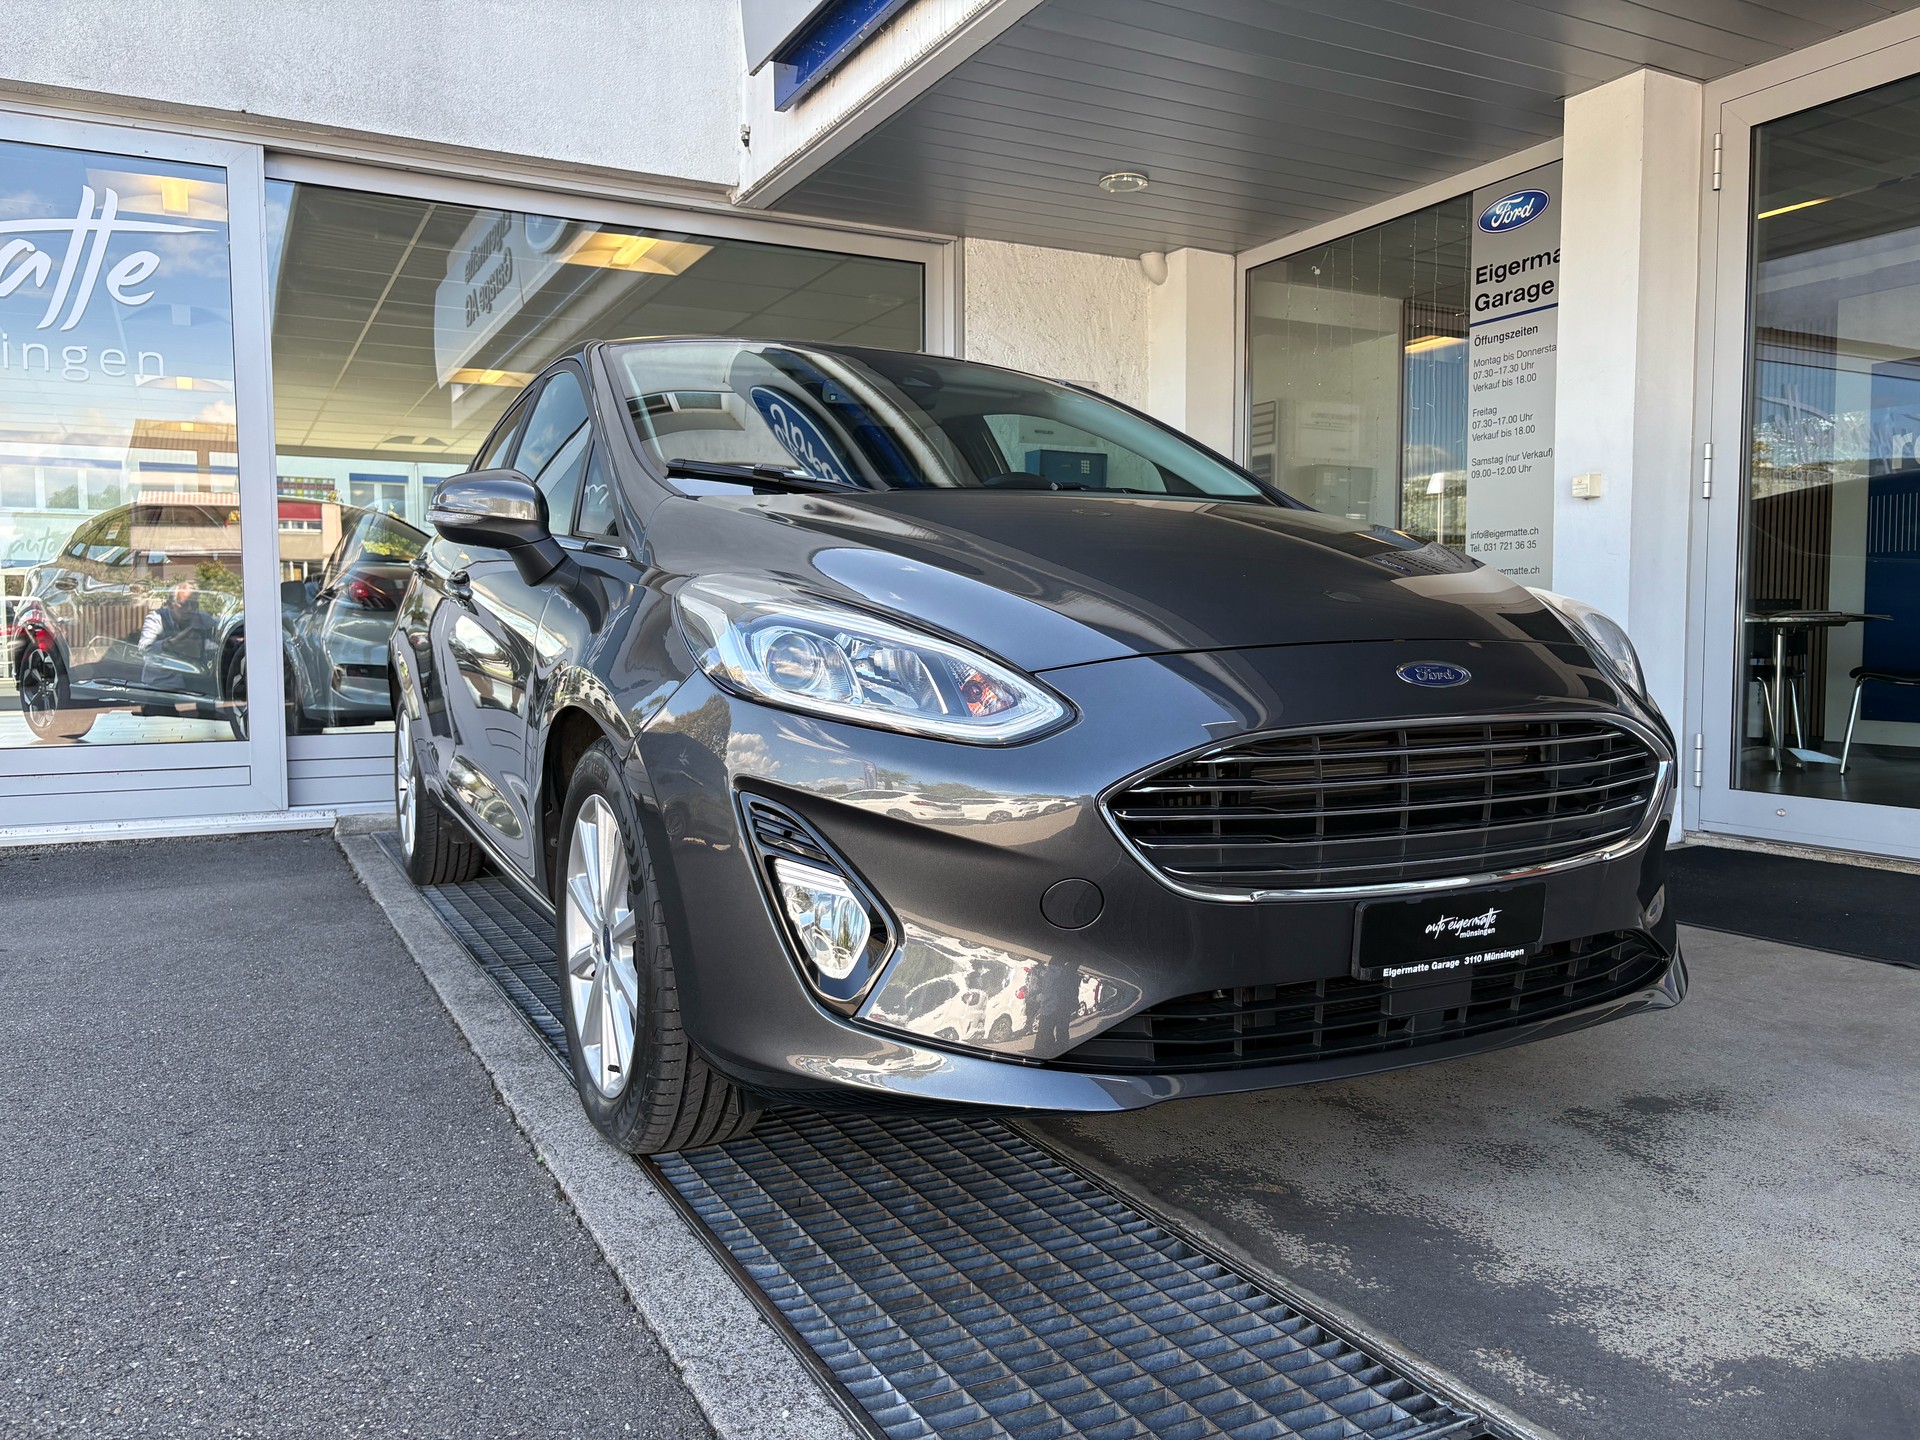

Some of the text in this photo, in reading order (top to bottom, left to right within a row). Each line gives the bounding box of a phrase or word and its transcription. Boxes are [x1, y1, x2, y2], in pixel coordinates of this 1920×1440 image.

[1474, 280, 1555, 312] Garage
[1473, 354, 1501, 368] Montag
[1503, 351, 1514, 362] bis
[1520, 361, 1535, 372] Uhr
[1473, 373, 1537, 393] Verkauf bis 18.00
[1472, 406, 1498, 418] Freitag
[1520, 412, 1534, 423] Uhr
[1472, 425, 1536, 442] Verkauf bis 18.00
[1471, 447, 1554, 468] Samstag (nur Verkauf)
[1518, 463, 1533, 474] Uhr
[1470, 526, 1539, 540] info@eigermatte.ch
[1470, 540, 1537, 553] Tel. 031 721 36 35
[1415, 666, 1455, 681] Ford
[1425, 907, 1502, 939] auto eigermatte
[1459, 926, 1496, 939] münsingen
[1383, 947, 1525, 978] Eigermatte Garage 3110 Münsingen
